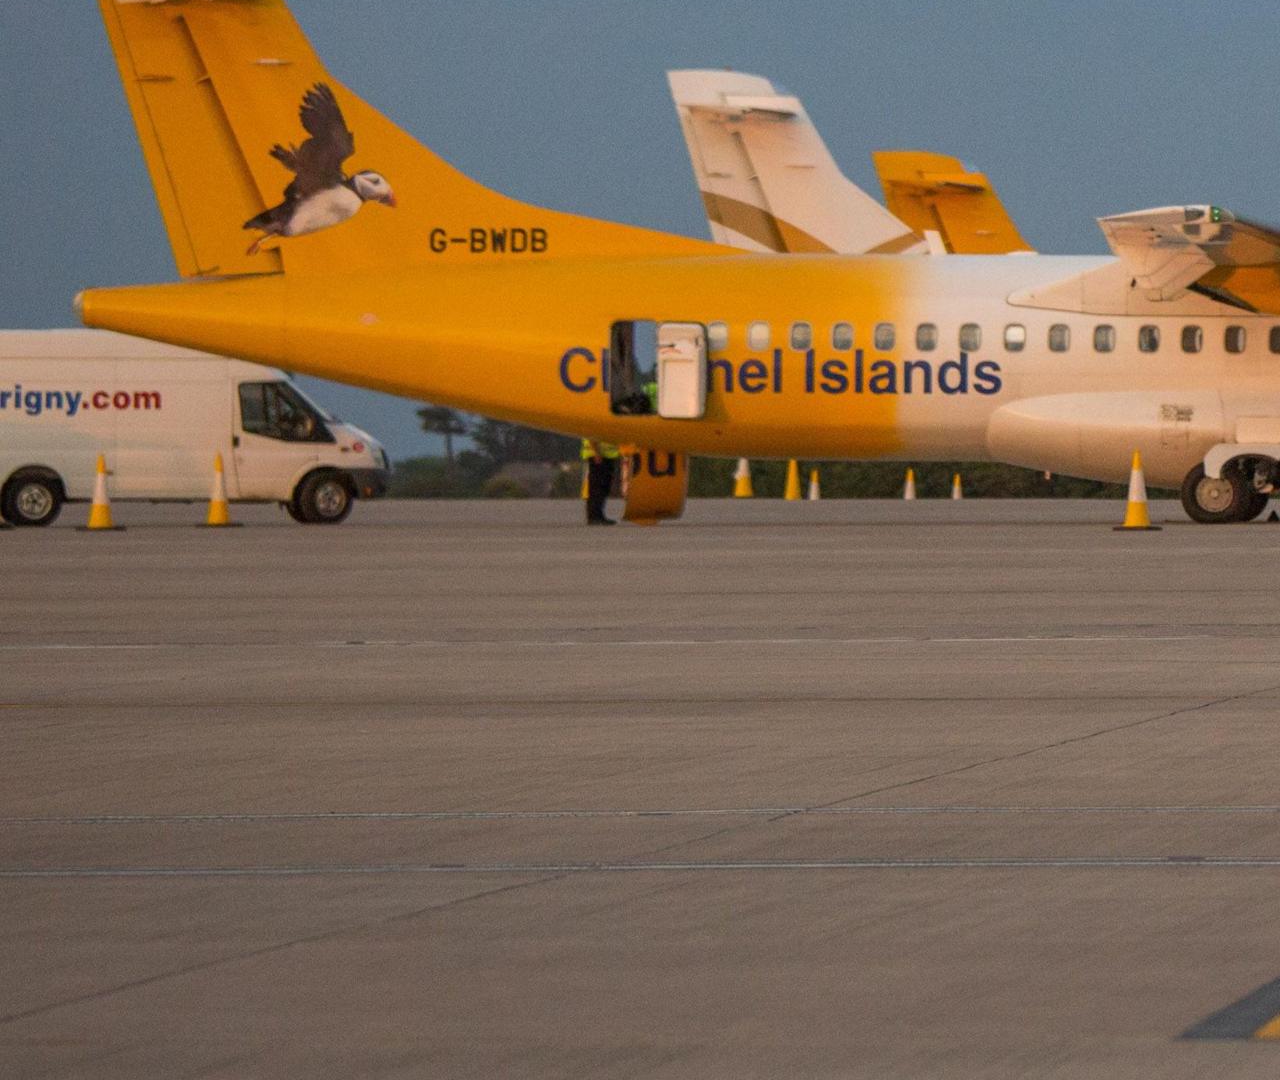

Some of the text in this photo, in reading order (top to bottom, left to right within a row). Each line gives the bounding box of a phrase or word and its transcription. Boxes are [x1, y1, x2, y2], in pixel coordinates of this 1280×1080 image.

[430, 228, 548, 253] G-BWDB
[560, 347, 1002, 394] Cnel Islands
[0, 384, 161, 416] rigny.com
